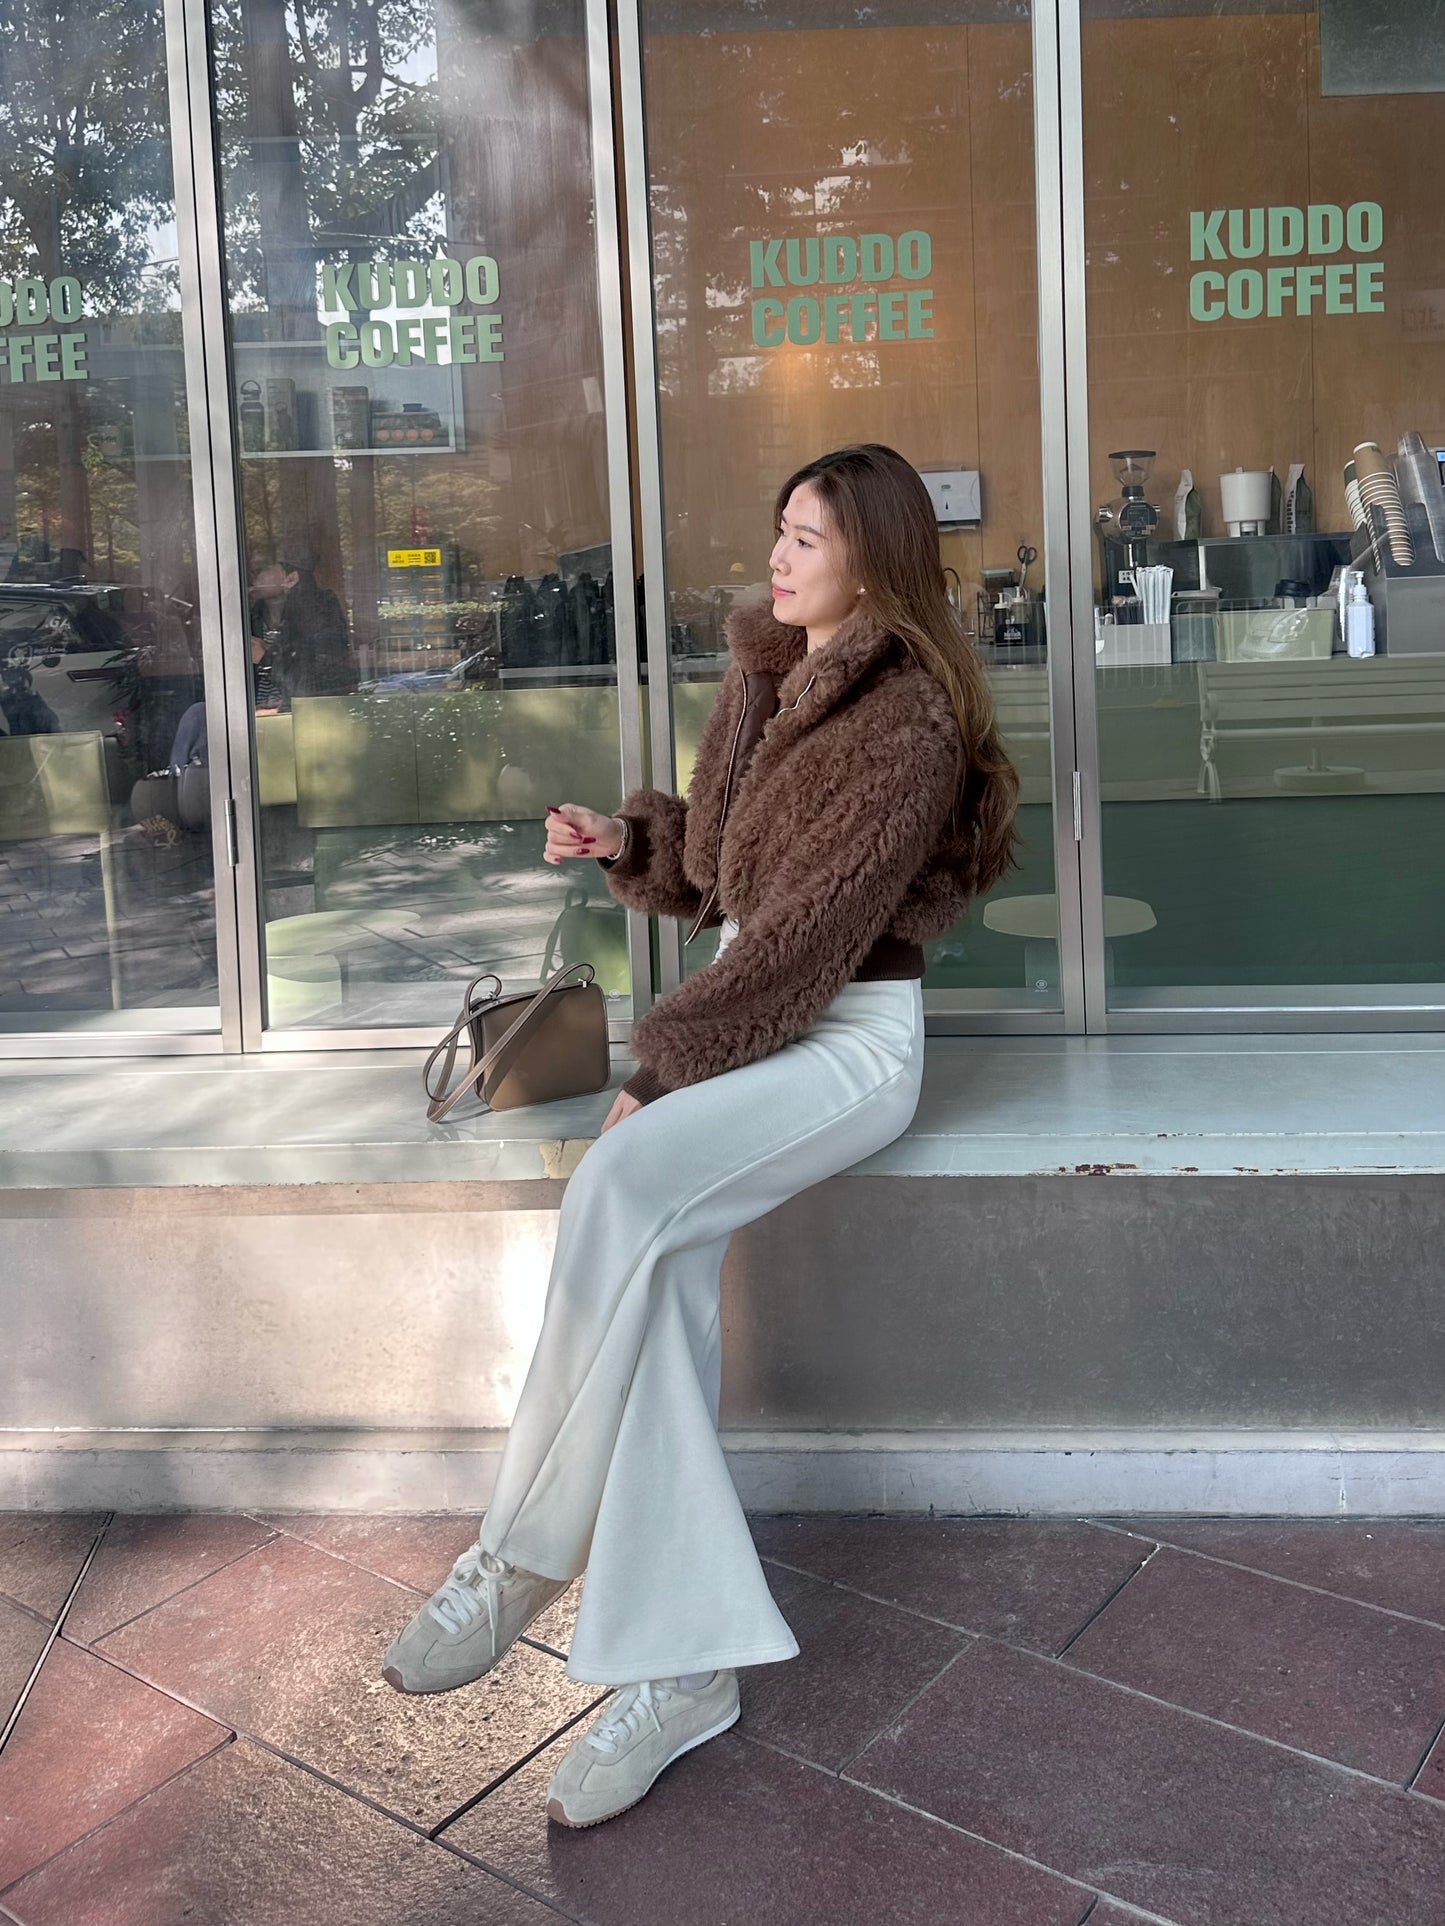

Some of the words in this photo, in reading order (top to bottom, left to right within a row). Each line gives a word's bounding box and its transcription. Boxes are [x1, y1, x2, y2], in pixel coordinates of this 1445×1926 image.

[750, 230, 932, 289] KUDDO
[1189, 201, 1384, 262] KUDDO
[322, 255, 500, 312] KUDDO
[1189, 262, 1385, 322] COFFEE
[325, 314, 505, 370] COFFEE
[751, 289, 935, 347] COFFEE
